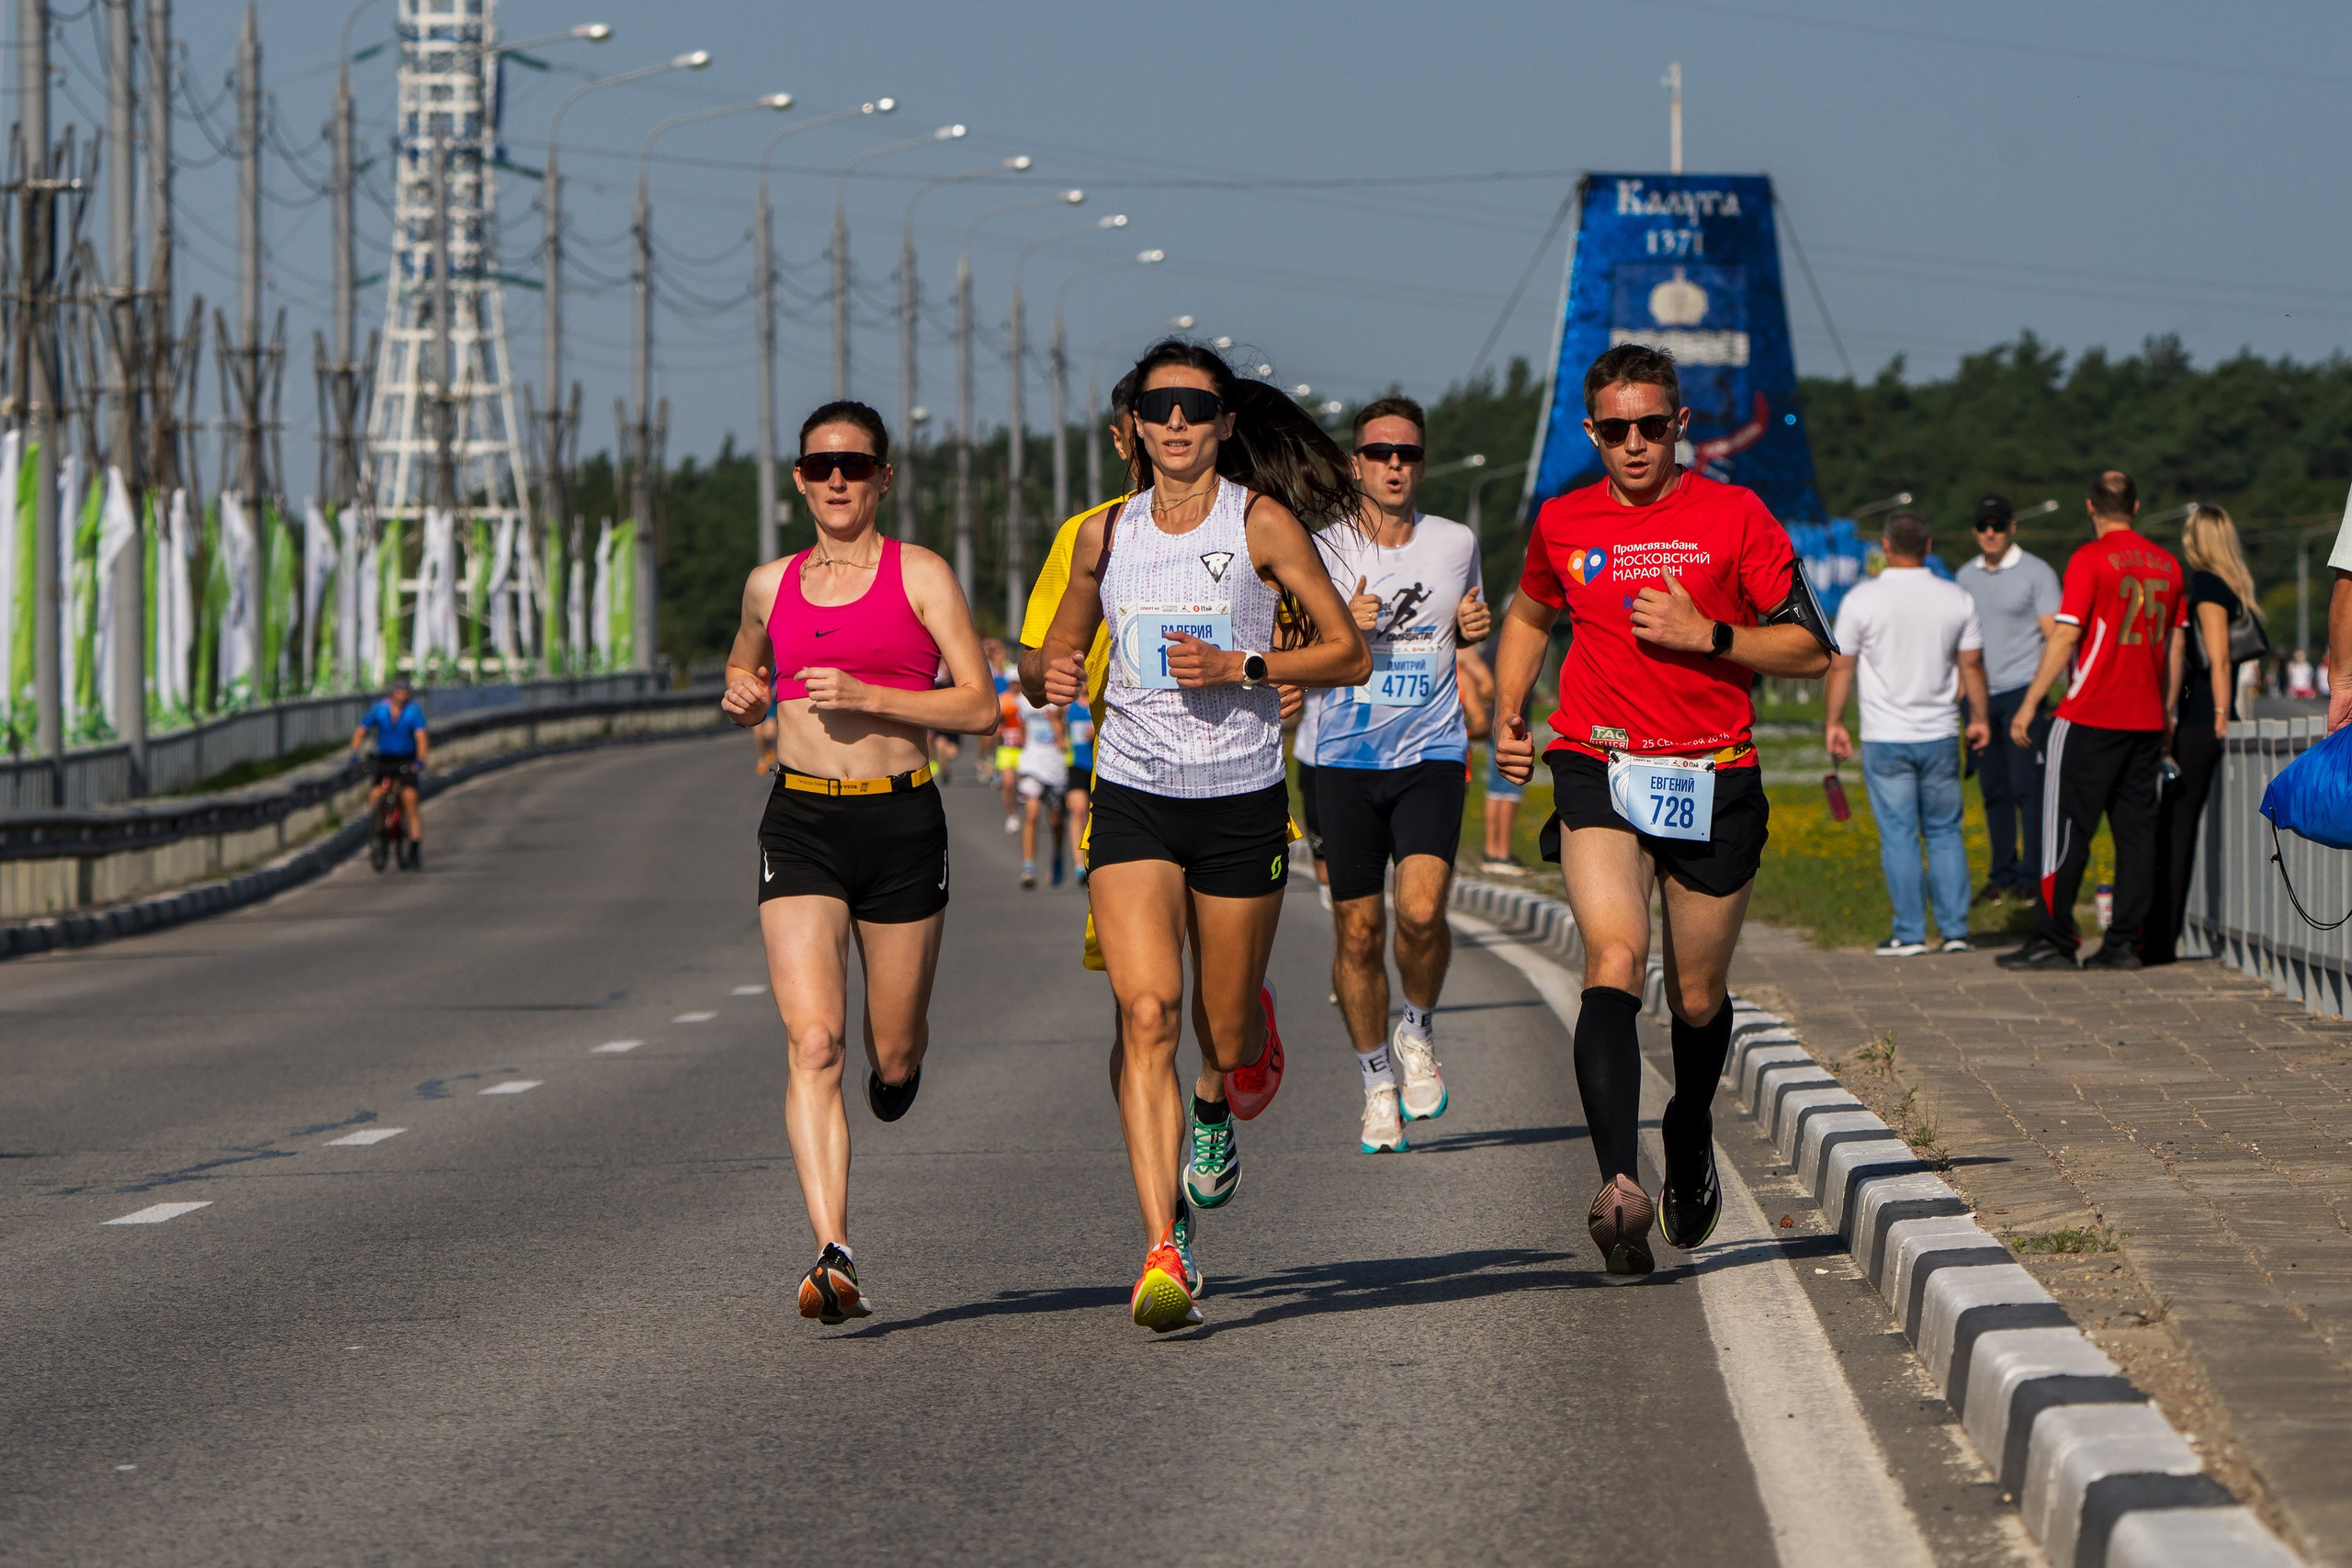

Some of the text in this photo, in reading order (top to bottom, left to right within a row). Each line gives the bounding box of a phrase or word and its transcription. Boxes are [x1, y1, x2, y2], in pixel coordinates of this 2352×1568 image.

[1645, 228, 1704, 255] 1371
[1612, 539, 1699, 555] Промсвязьбанк
[1612, 551, 1711, 569] МОСКОВСКИЙ
[2107, 549, 2173, 573] RUSSIA
[2118, 575, 2170, 647] 25
[1386, 659, 1427, 672] ДМИТРИЙ
[1381, 674, 1430, 698] 4775
[1594, 727, 1625, 740] TAG
[1642, 739, 1655, 749] 25
[1650, 775, 1695, 794] ЕВГЕНИЙ
[1649, 795, 1695, 829] 728
